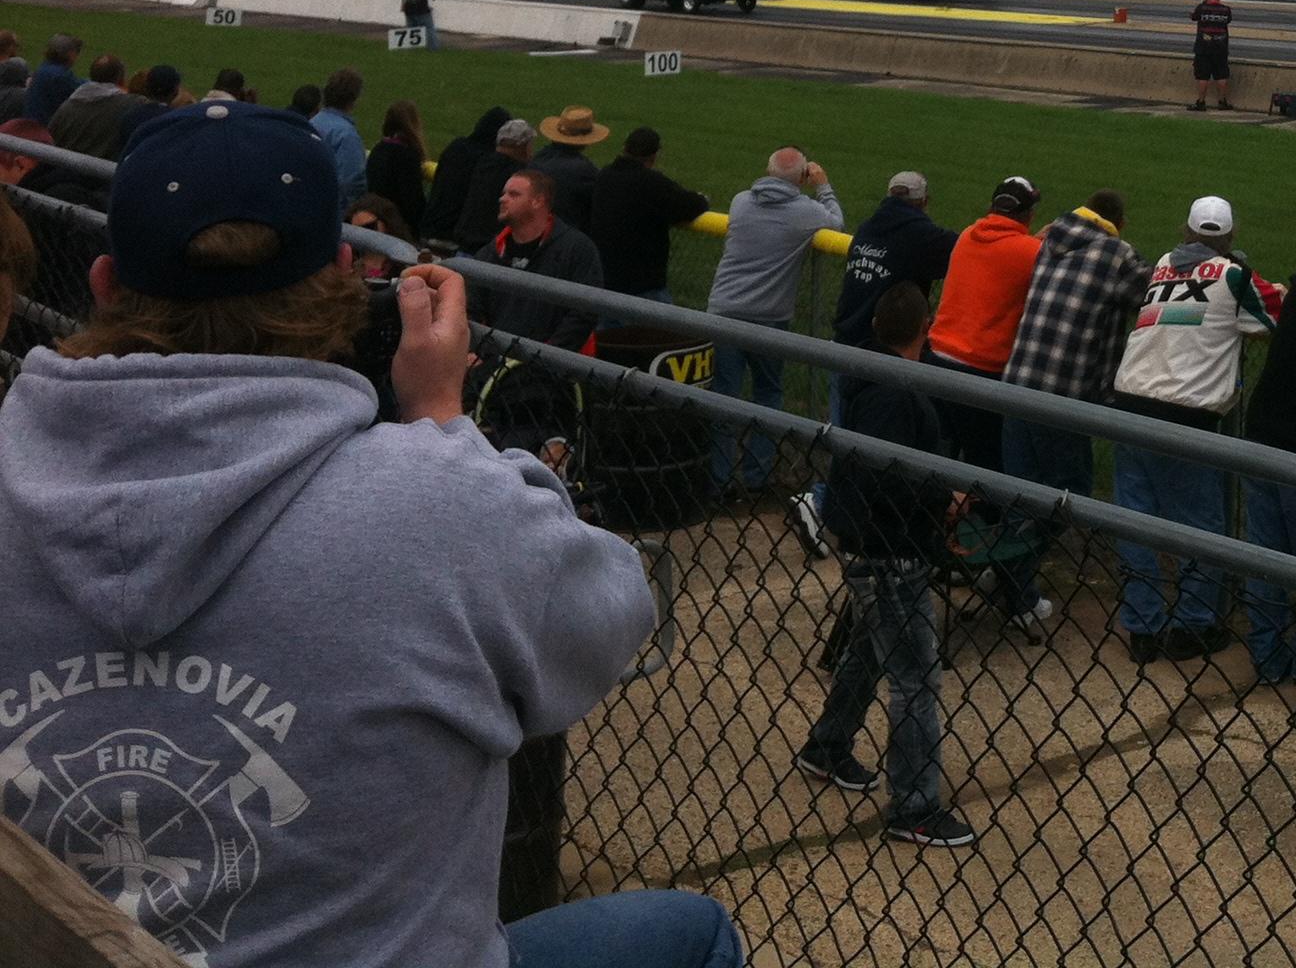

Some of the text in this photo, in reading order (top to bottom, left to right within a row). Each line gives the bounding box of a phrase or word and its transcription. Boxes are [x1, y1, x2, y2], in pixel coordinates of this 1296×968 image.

[213, 9, 236, 24] 50
[395, 28, 422, 47] 75
[648, 52, 678, 73] 100
[854, 269, 872, 283] Tap
[0, 651, 298, 744] CAZENOVIA
[97, 745, 173, 775] FIRE
